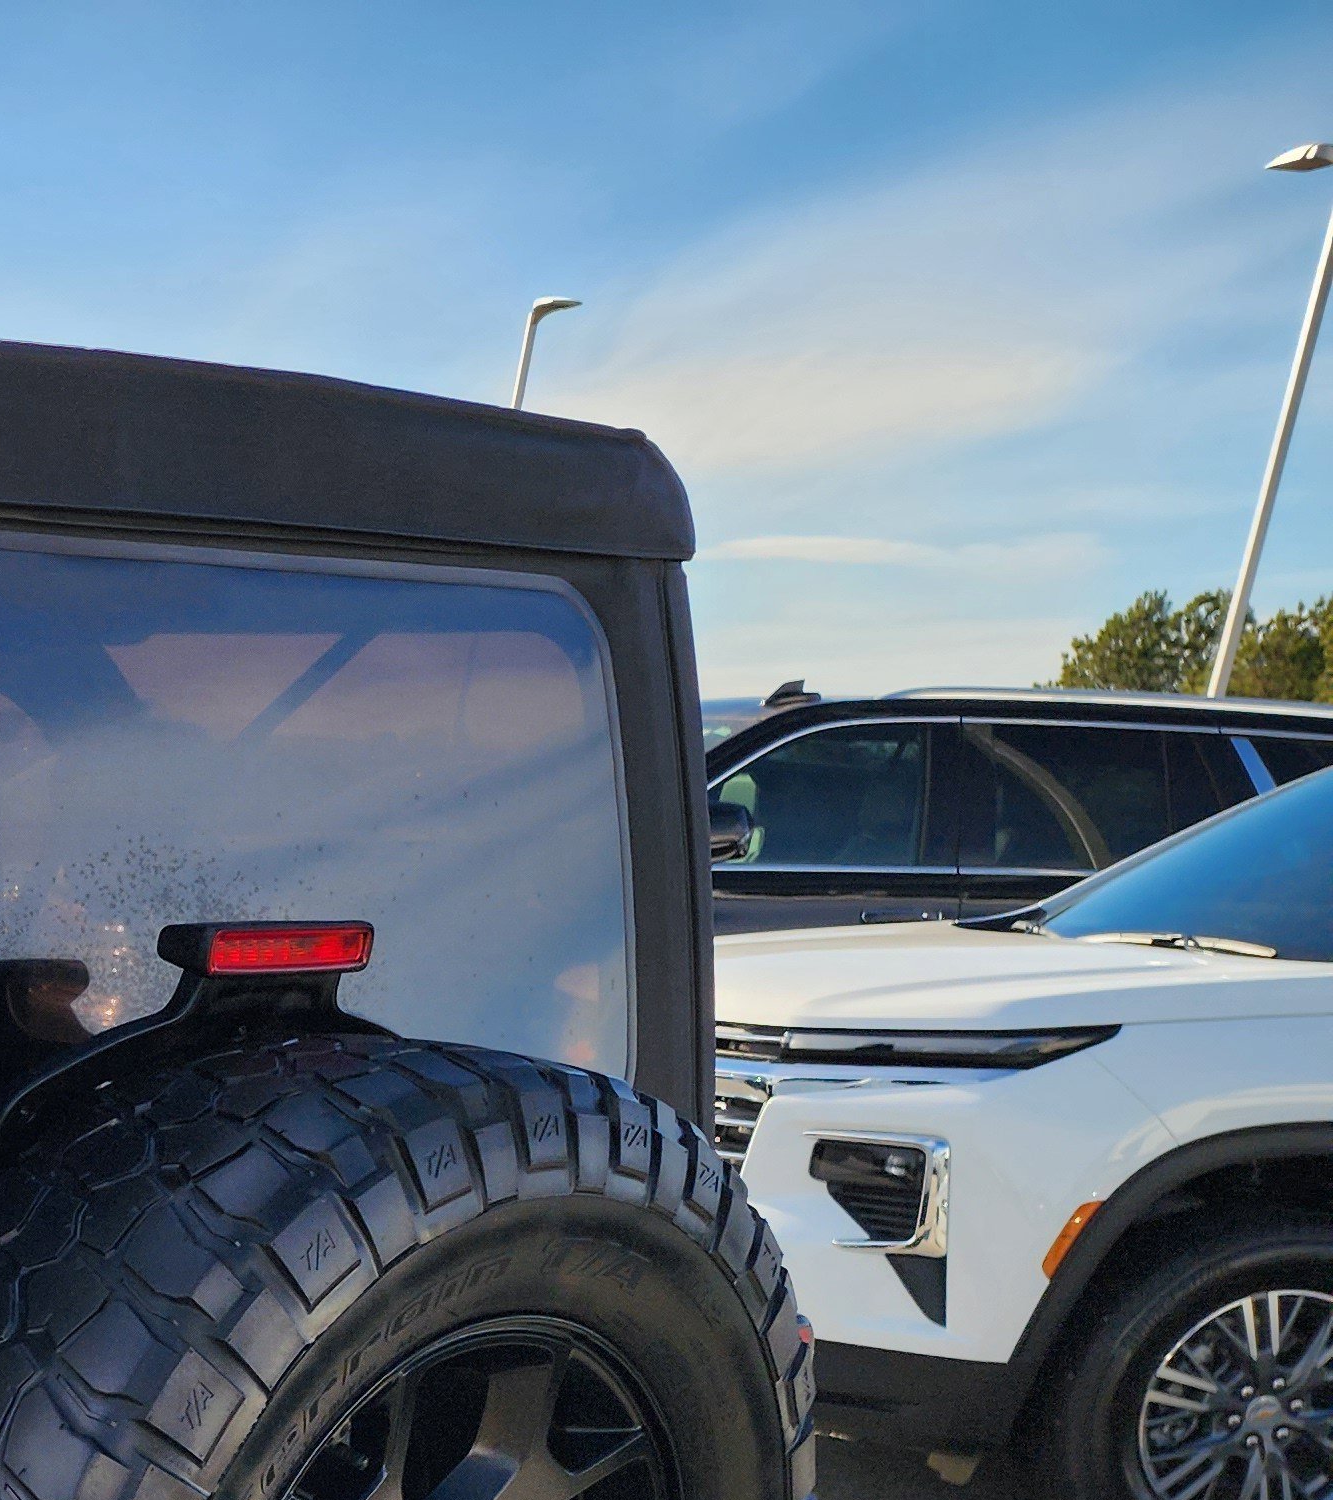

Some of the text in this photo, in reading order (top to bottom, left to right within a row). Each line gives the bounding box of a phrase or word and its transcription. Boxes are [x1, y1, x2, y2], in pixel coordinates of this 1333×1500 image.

[533, 1114, 559, 1142] T/A
[623, 1122, 648, 1148] T/A
[427, 1144, 457, 1178] T/A
[699, 1162, 719, 1193] T/A
[299, 1228, 336, 1271] T/A
[180, 1382, 215, 1430] T/A
